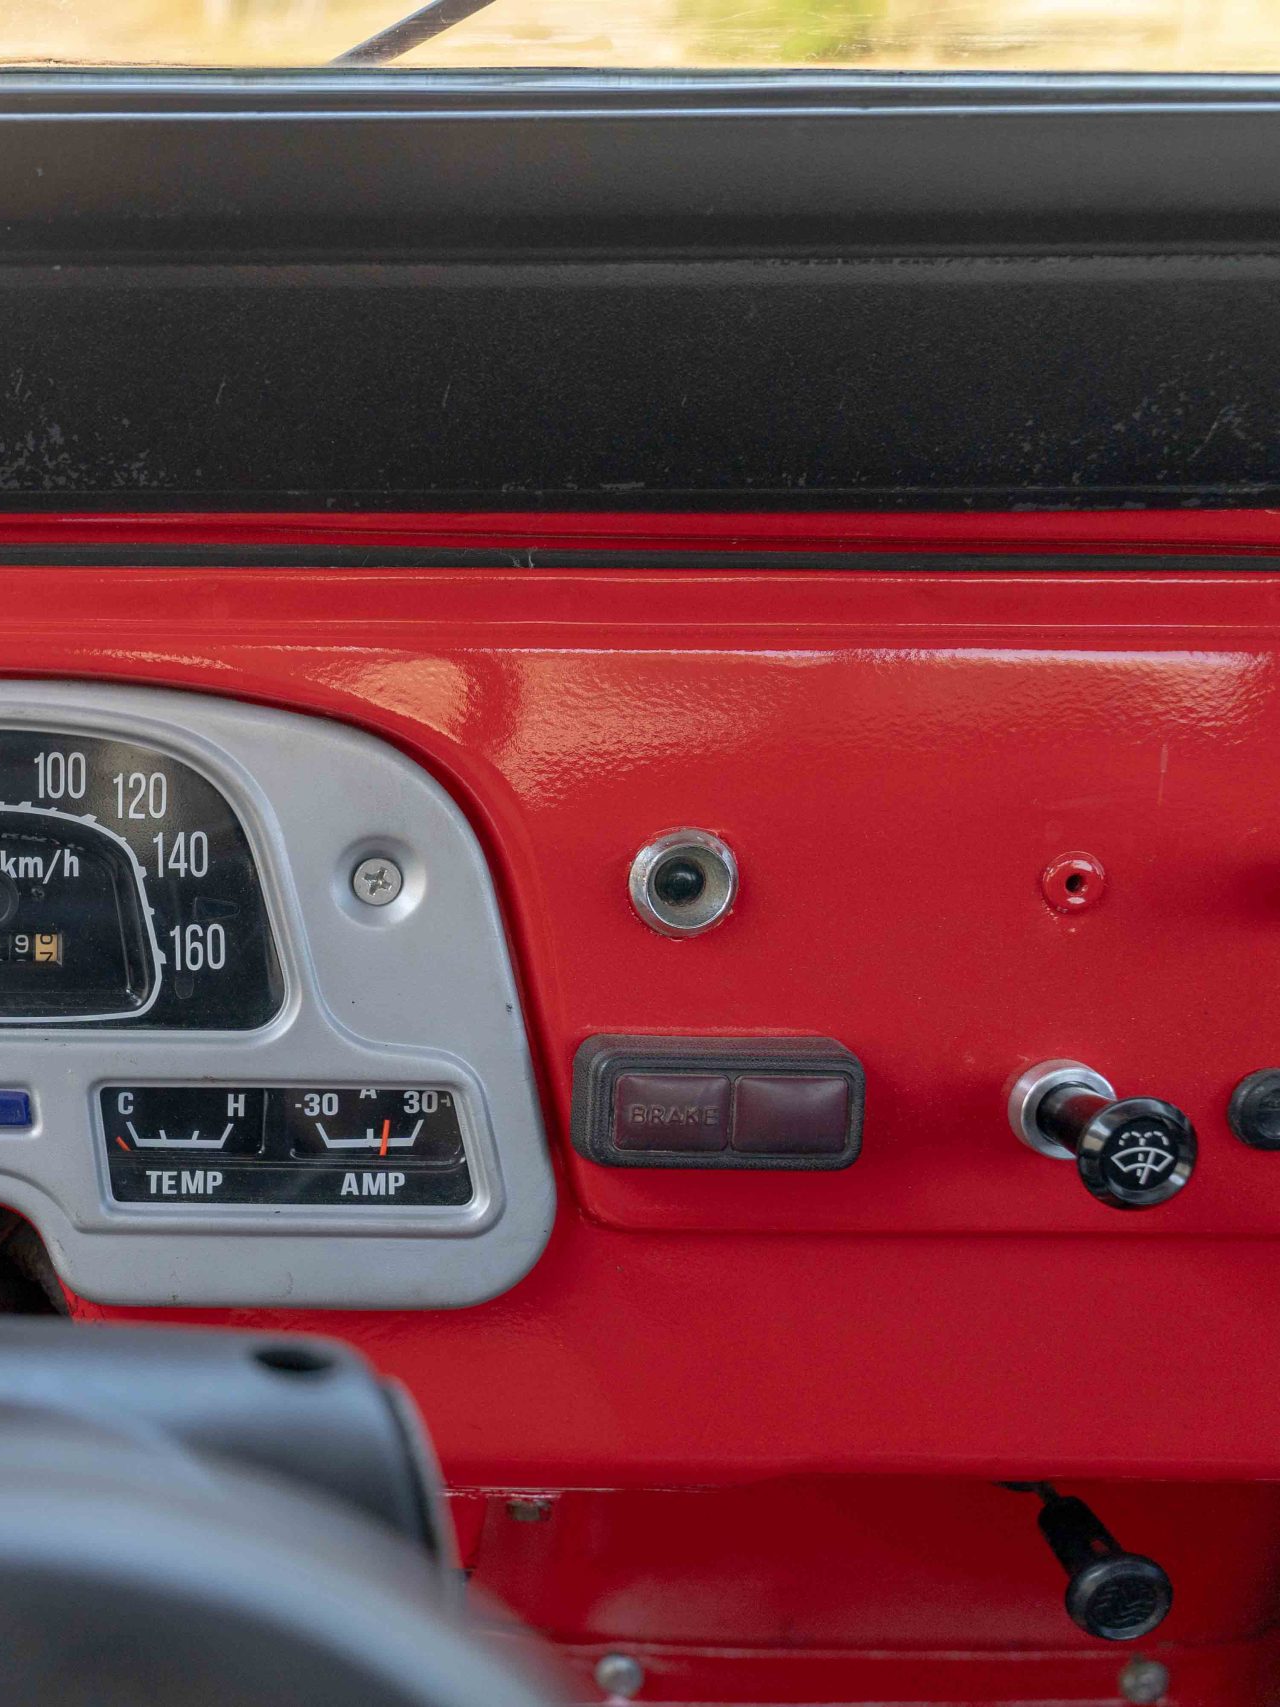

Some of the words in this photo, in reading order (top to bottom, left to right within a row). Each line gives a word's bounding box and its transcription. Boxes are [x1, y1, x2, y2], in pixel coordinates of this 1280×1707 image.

[34, 752, 86, 799] 100
[113, 772, 167, 819] 120
[0, 848, 80, 885] km/h
[154, 831, 208, 878] 140
[170, 924, 225, 970] 160
[118, 1092, 134, 1115] C
[228, 1094, 245, 1116] H
[295, 1093, 339, 1116] -30
[629, 1103, 720, 1126] BRAKE
[146, 1170, 223, 1195] TEMP
[341, 1172, 406, 1196] AMP
